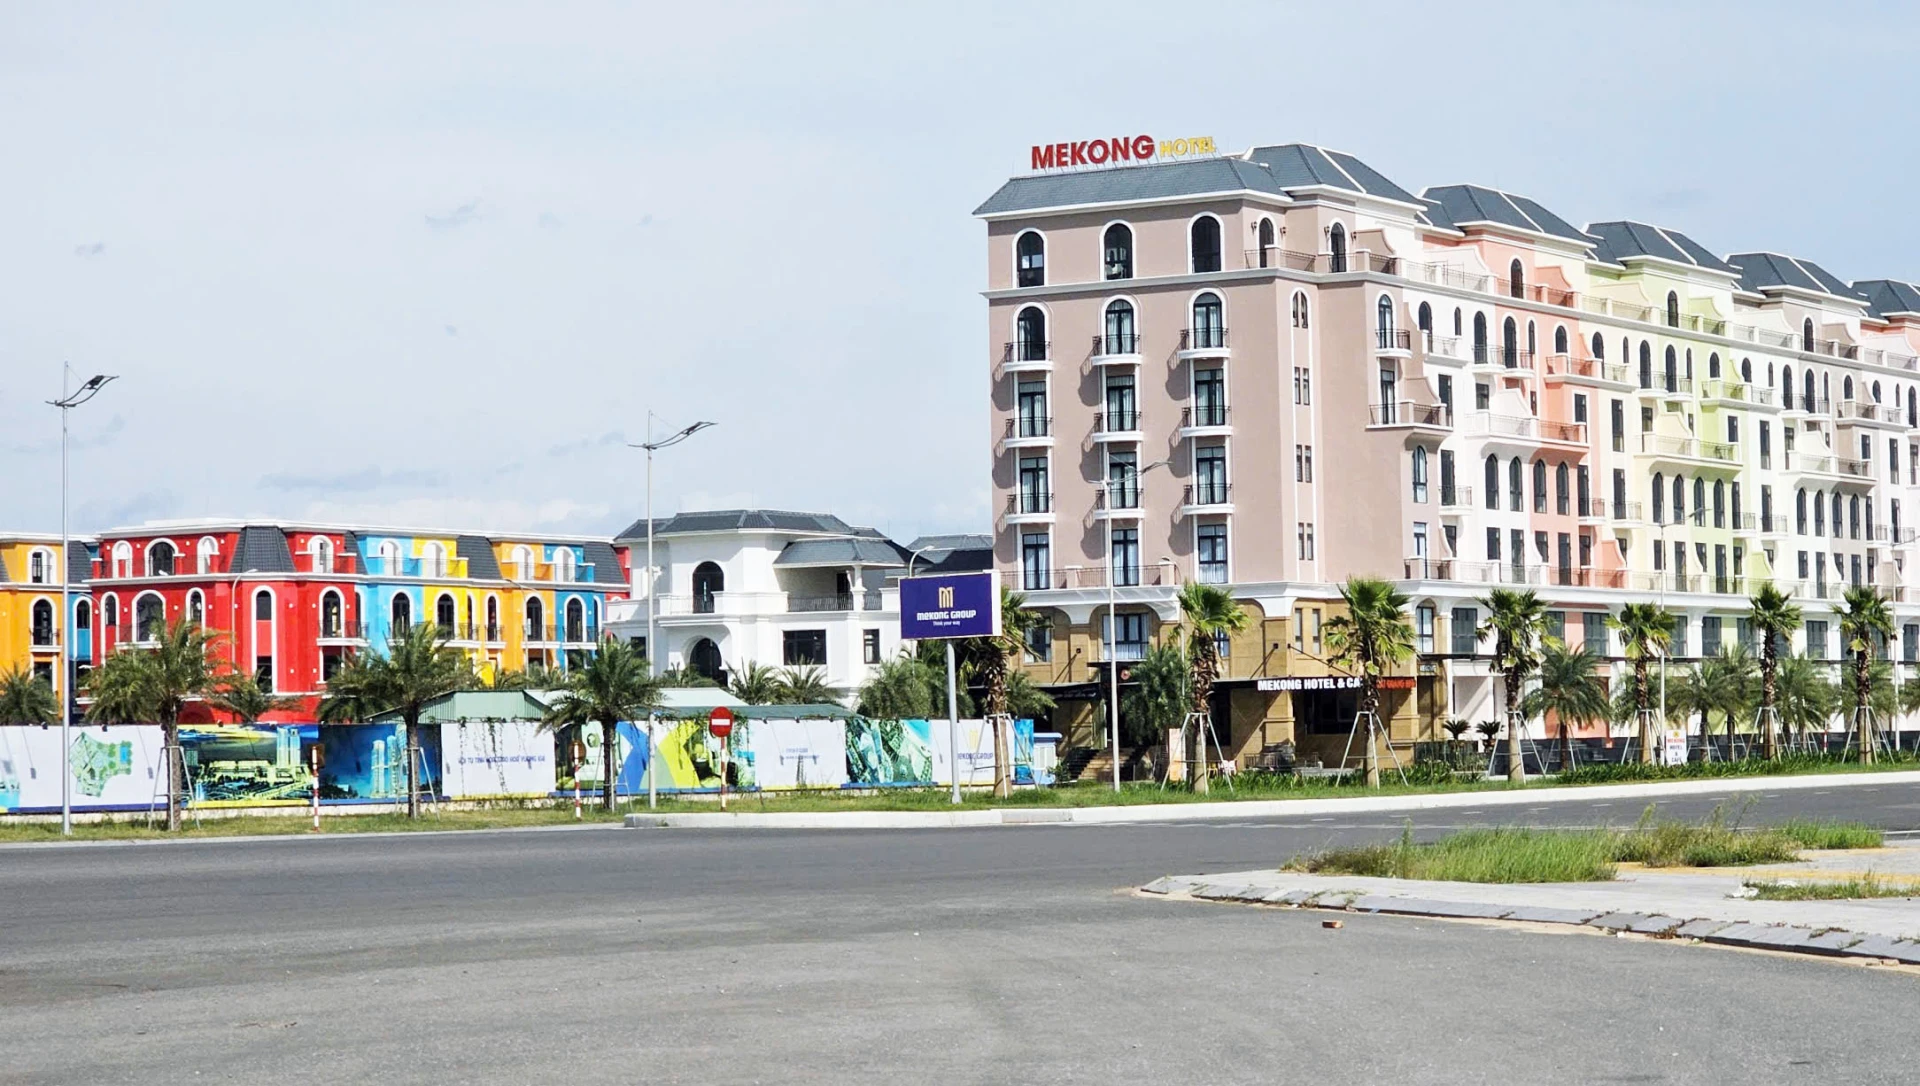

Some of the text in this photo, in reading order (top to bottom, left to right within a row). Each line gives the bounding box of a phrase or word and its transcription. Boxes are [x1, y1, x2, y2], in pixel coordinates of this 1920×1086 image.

[1031, 135, 1216, 170] MEKONG HOTEL
[950, 609, 977, 620] GROUP
[1257, 678, 1302, 691] MEKONG
[1303, 678, 1336, 690] HOTEL
[1337, 678, 1345, 688] &
